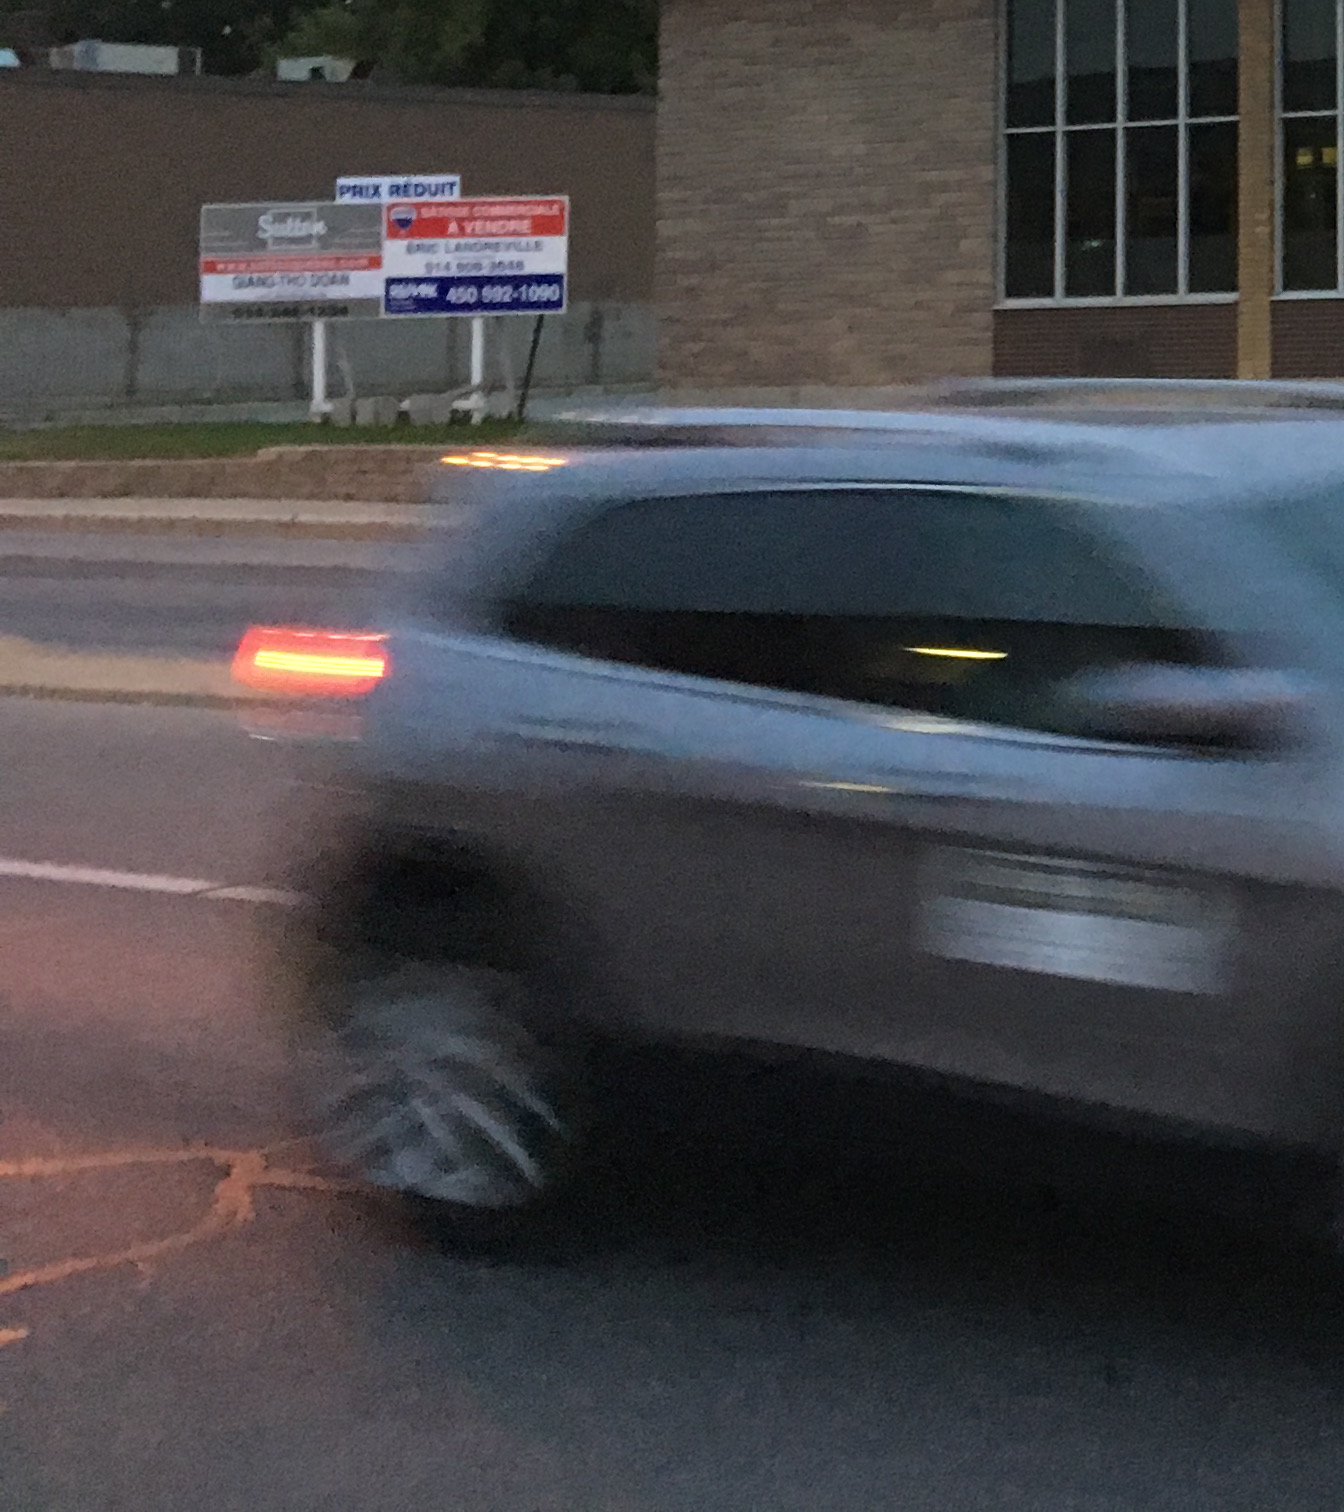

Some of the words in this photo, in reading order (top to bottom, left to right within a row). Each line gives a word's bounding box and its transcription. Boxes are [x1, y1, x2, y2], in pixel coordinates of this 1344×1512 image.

[338, 184, 382, 199] PRIX
[256, 213, 328, 239] Sutton
[463, 218, 532, 235] VENDRE
